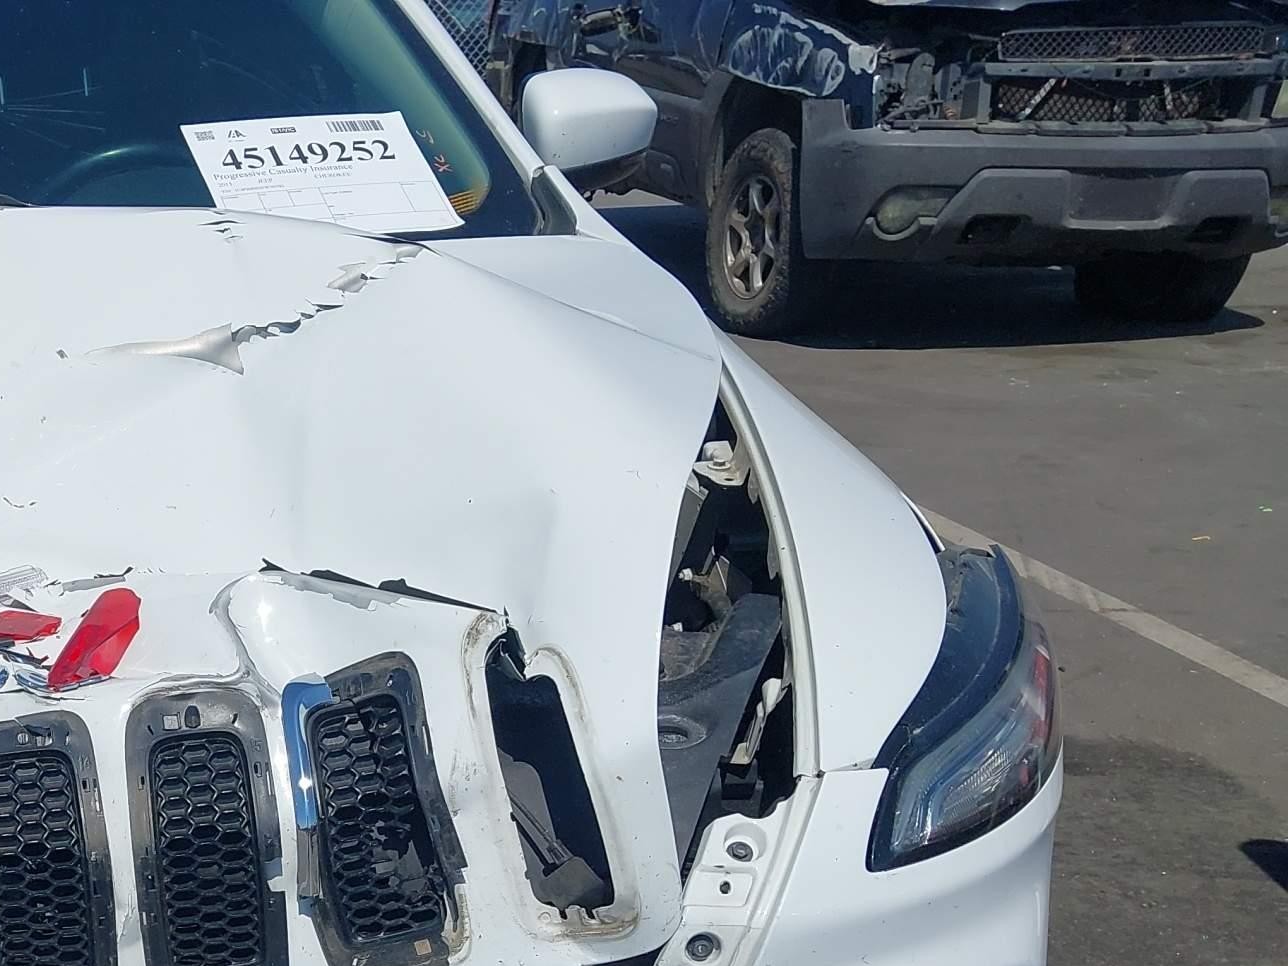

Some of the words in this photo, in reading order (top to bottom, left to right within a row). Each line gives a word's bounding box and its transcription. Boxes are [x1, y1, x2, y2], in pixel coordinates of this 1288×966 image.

[222, 139, 396, 170] 45149252
[213, 169, 268, 182] Progressive
[268, 166, 308, 176] Casualty
[309, 164, 353, 174] Insurance
